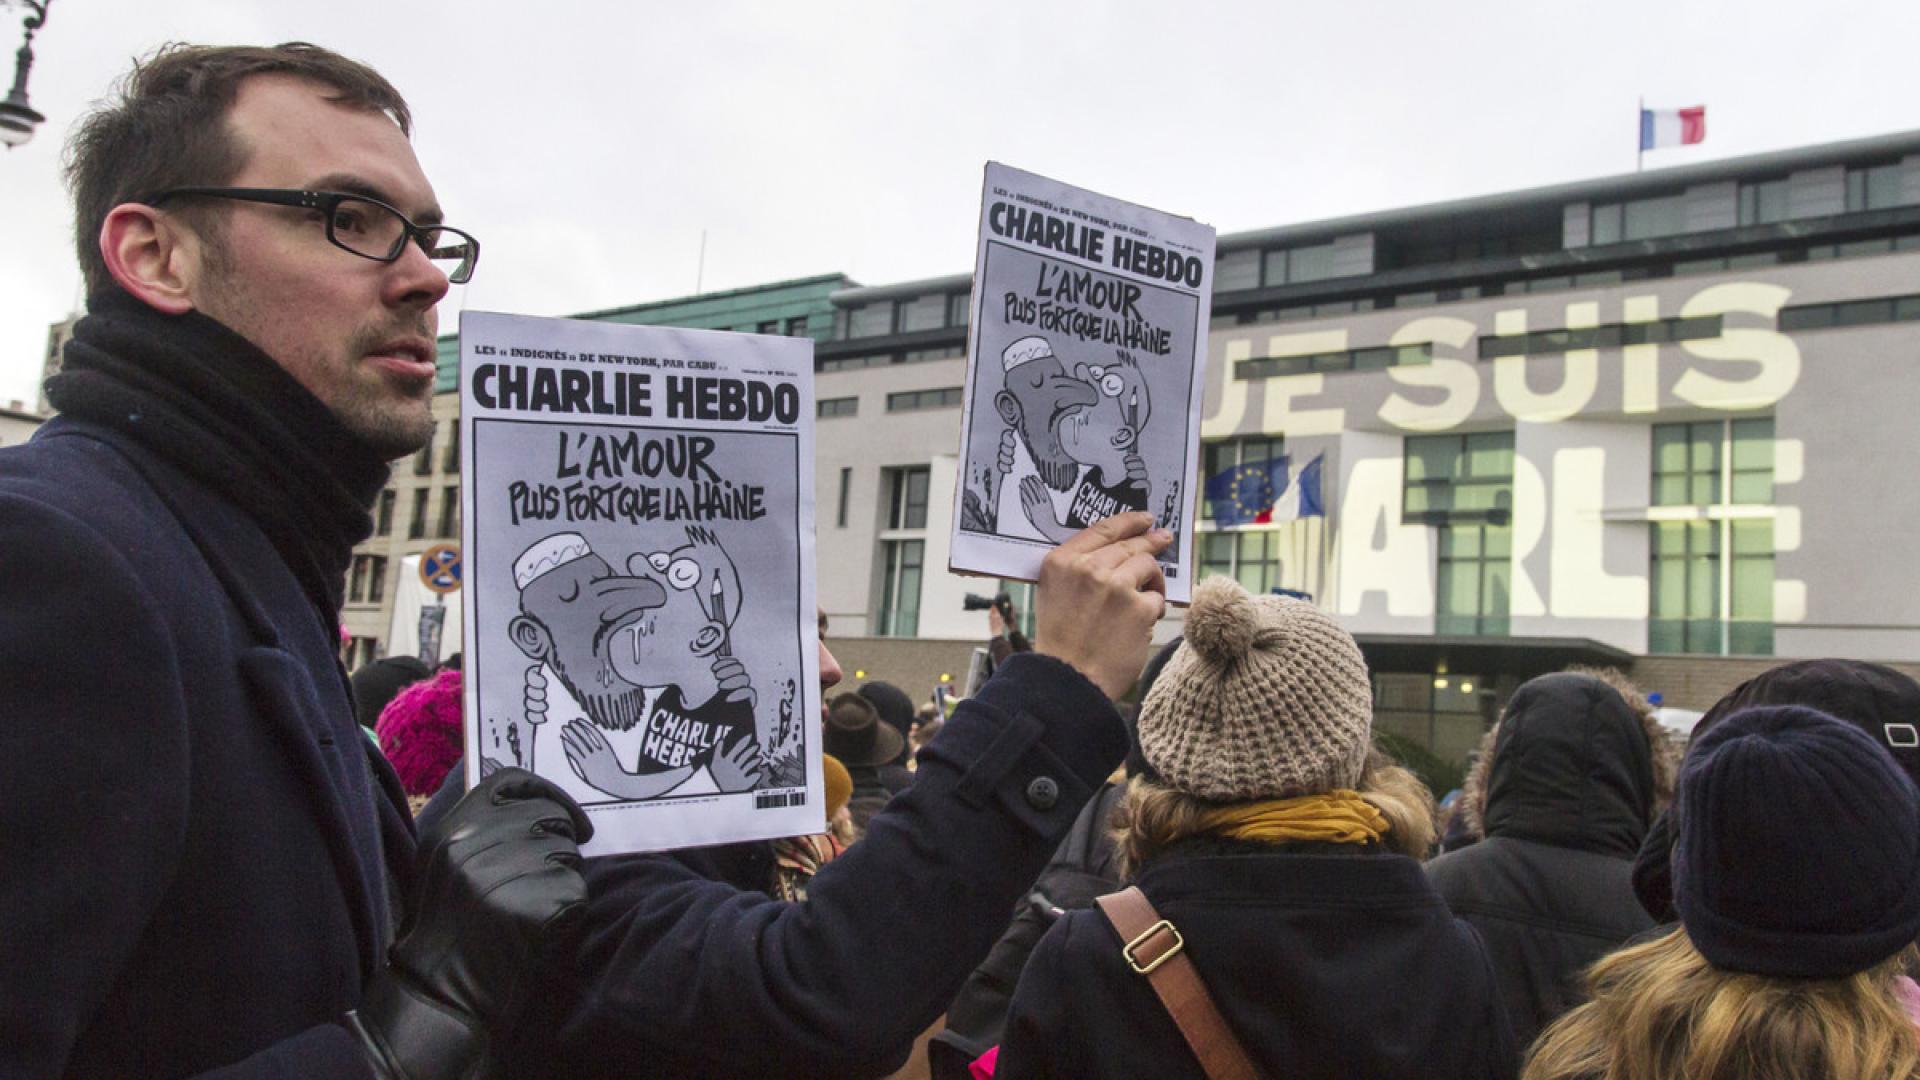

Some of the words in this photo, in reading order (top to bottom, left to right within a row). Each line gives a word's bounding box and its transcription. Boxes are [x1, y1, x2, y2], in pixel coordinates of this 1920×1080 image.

[989, 201, 1104, 263] CHARLIE
[1112, 235, 1203, 288] HEBDO
[1004, 292, 1036, 325] PLUS
[1038, 300, 1077, 336] FORT
[1072, 311, 1102, 341] QUE
[1103, 318, 1122, 346] LA
[1036, 261, 1144, 322] L'AMOUR
[475, 345, 496, 355] LES
[511, 347, 567, 361] INDIGNÉS
[580, 353, 595, 363] DE
[598, 354, 624, 364] NEW
[663, 359, 684, 369] PAR
[1200, 329, 1348, 439] JE
[1377, 281, 1801, 432] SUIS
[472, 363, 652, 417] CHARLIE
[666, 375, 799, 424] HEBDO
[557, 430, 722, 483] L'AMOUR
[508, 480, 560, 525] PLUS
[563, 480, 622, 522] FORT
[617, 484, 660, 525] QUE
[664, 487, 693, 521] LA
